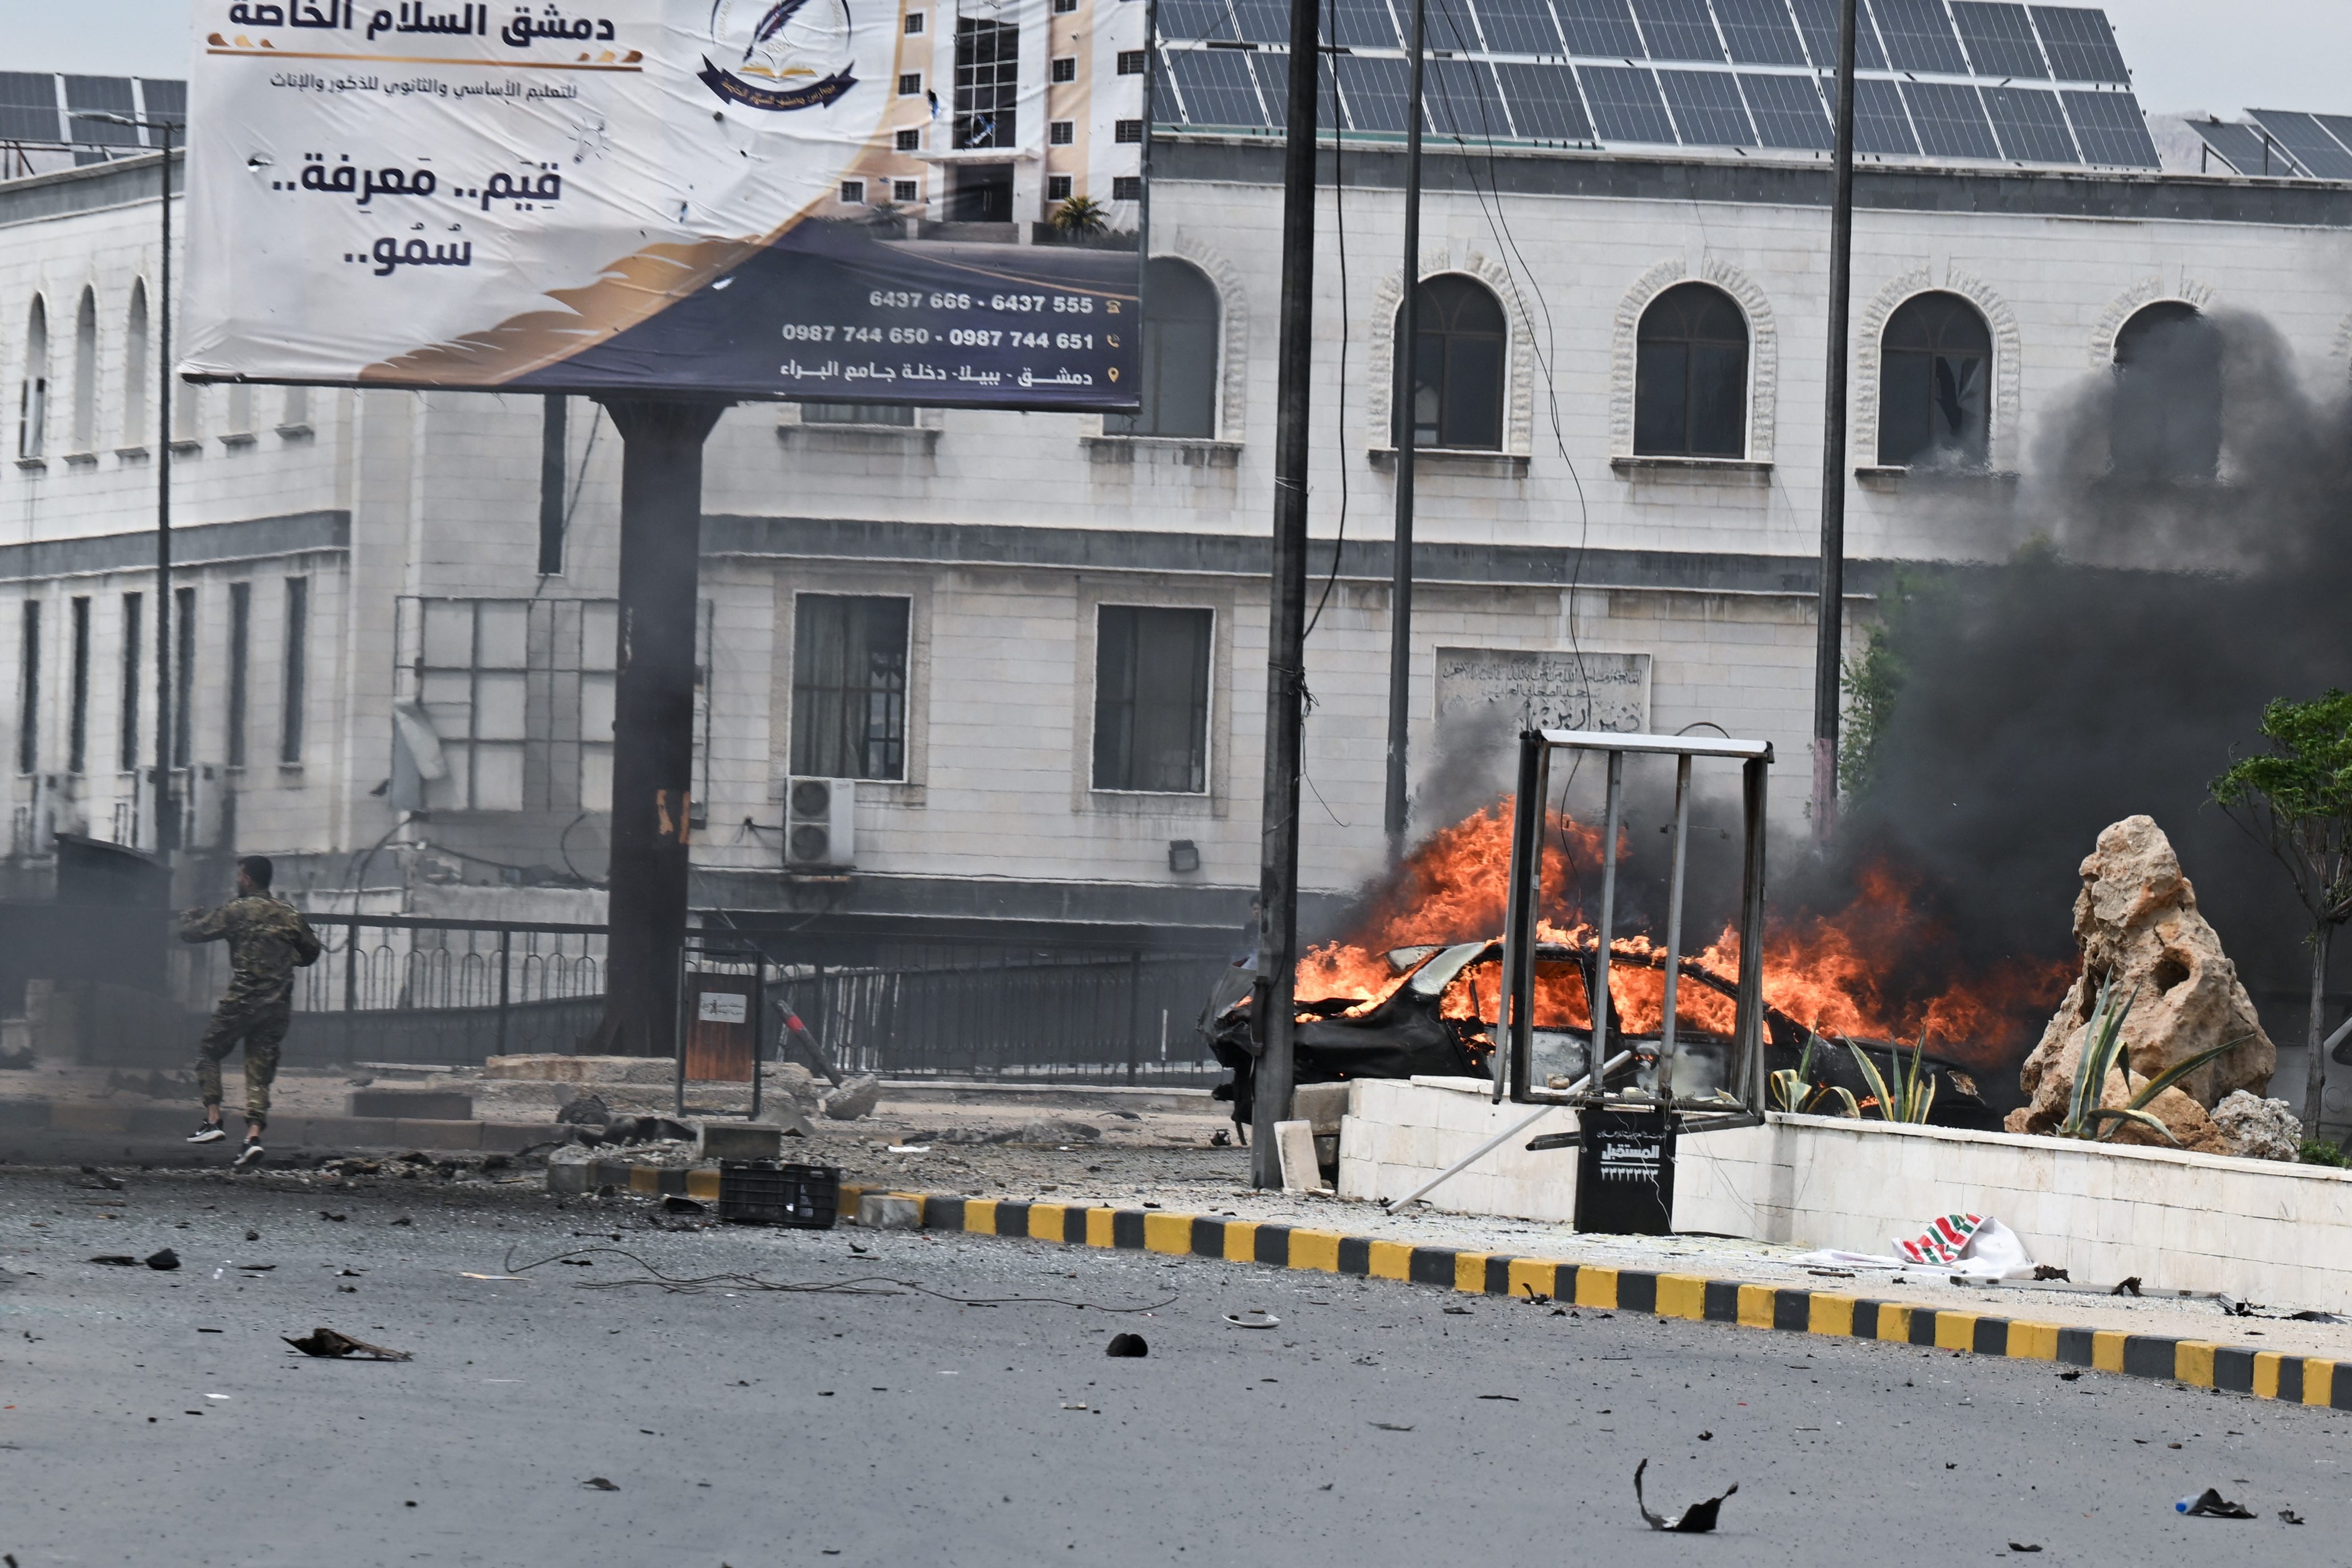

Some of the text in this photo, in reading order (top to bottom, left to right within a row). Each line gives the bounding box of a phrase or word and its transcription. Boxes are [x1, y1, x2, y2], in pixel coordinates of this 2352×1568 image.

[367, 1, 487, 40] السلام
[501, 3, 615, 47] دمشق
[270, 72, 577, 105] للتعليم الأساسي والثانوي للذكور والإناث
[869, 291, 922, 308] 6437
[930, 292, 970, 310] 666
[991, 294, 1046, 312] 6437
[1053, 296, 1093, 314] 555
[782, 323, 835, 342] 0987
[842, 326, 883, 342] 744
[889, 327, 929, 345] 650
[949, 328, 1003, 346] 0987
[1010, 331, 1050, 348] 744
[1056, 332, 1093, 350] 651
[779, 359, 839, 381] البراء
[844, 361, 897, 382] جامع
[901, 363, 947, 381] دخلة
[1602, 1143, 1660, 1160] المستقبل
